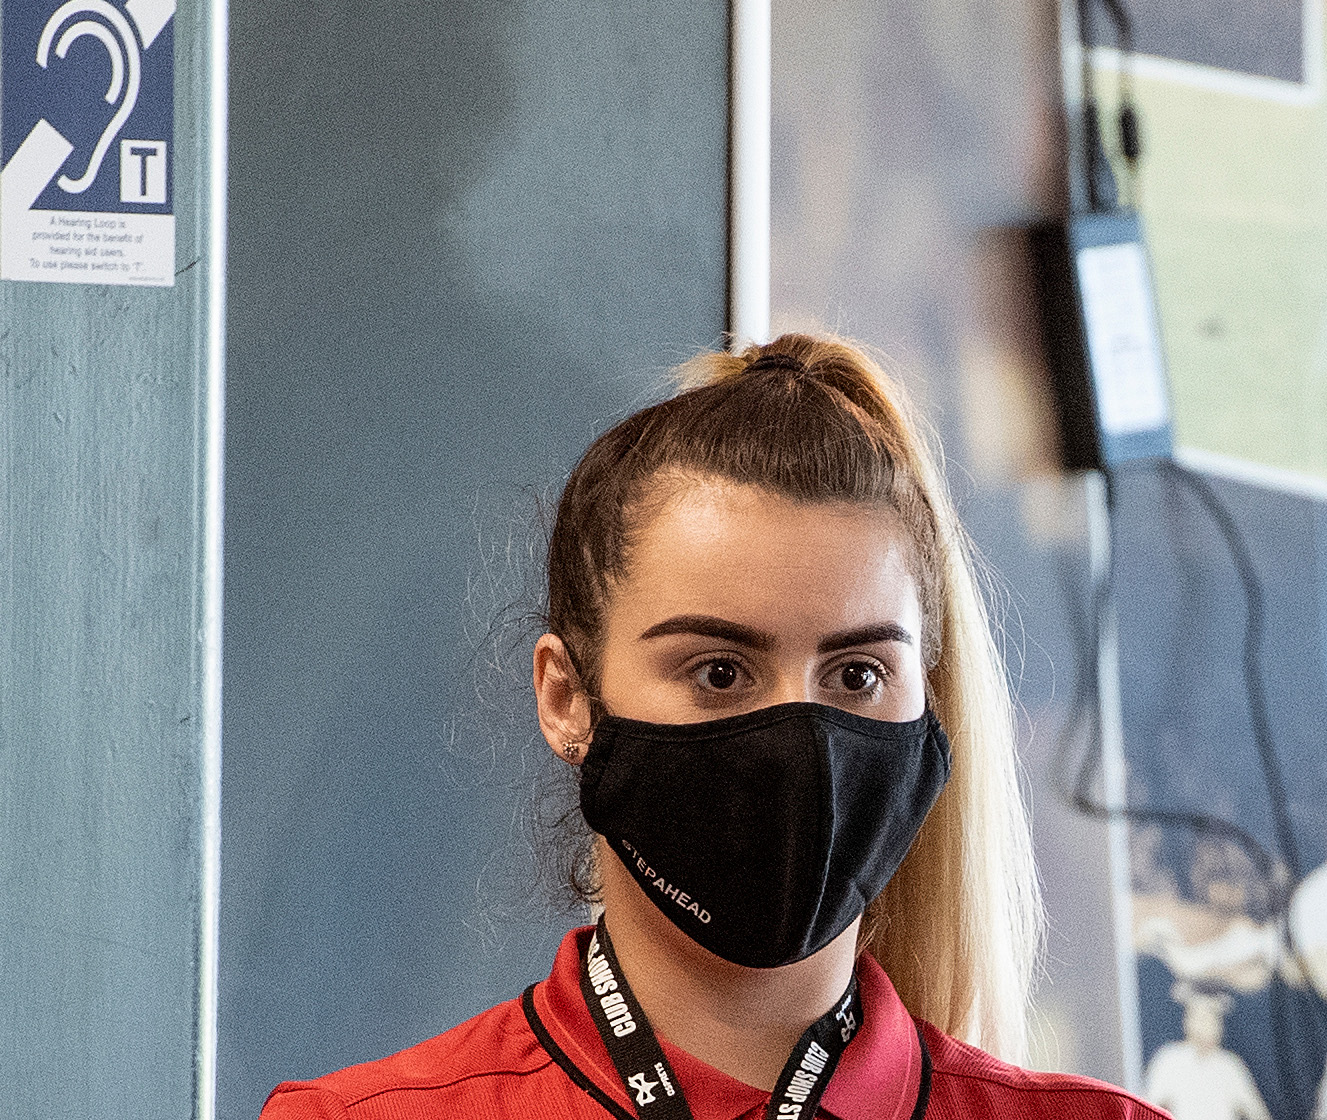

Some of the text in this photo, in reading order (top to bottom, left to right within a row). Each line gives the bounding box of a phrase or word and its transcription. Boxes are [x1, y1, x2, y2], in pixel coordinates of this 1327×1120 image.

[130, 147, 158, 196] T
[32, 231, 71, 241] provided
[87, 233, 100, 242] the
[58, 217, 91, 229] Hearing
[94, 218, 116, 229] Loop
[49, 246, 82, 258] hearing
[587, 954, 637, 1038] CLUB SHOP
[800, 1041, 829, 1074] CLUB
[784, 1070, 818, 1103] SHOP
